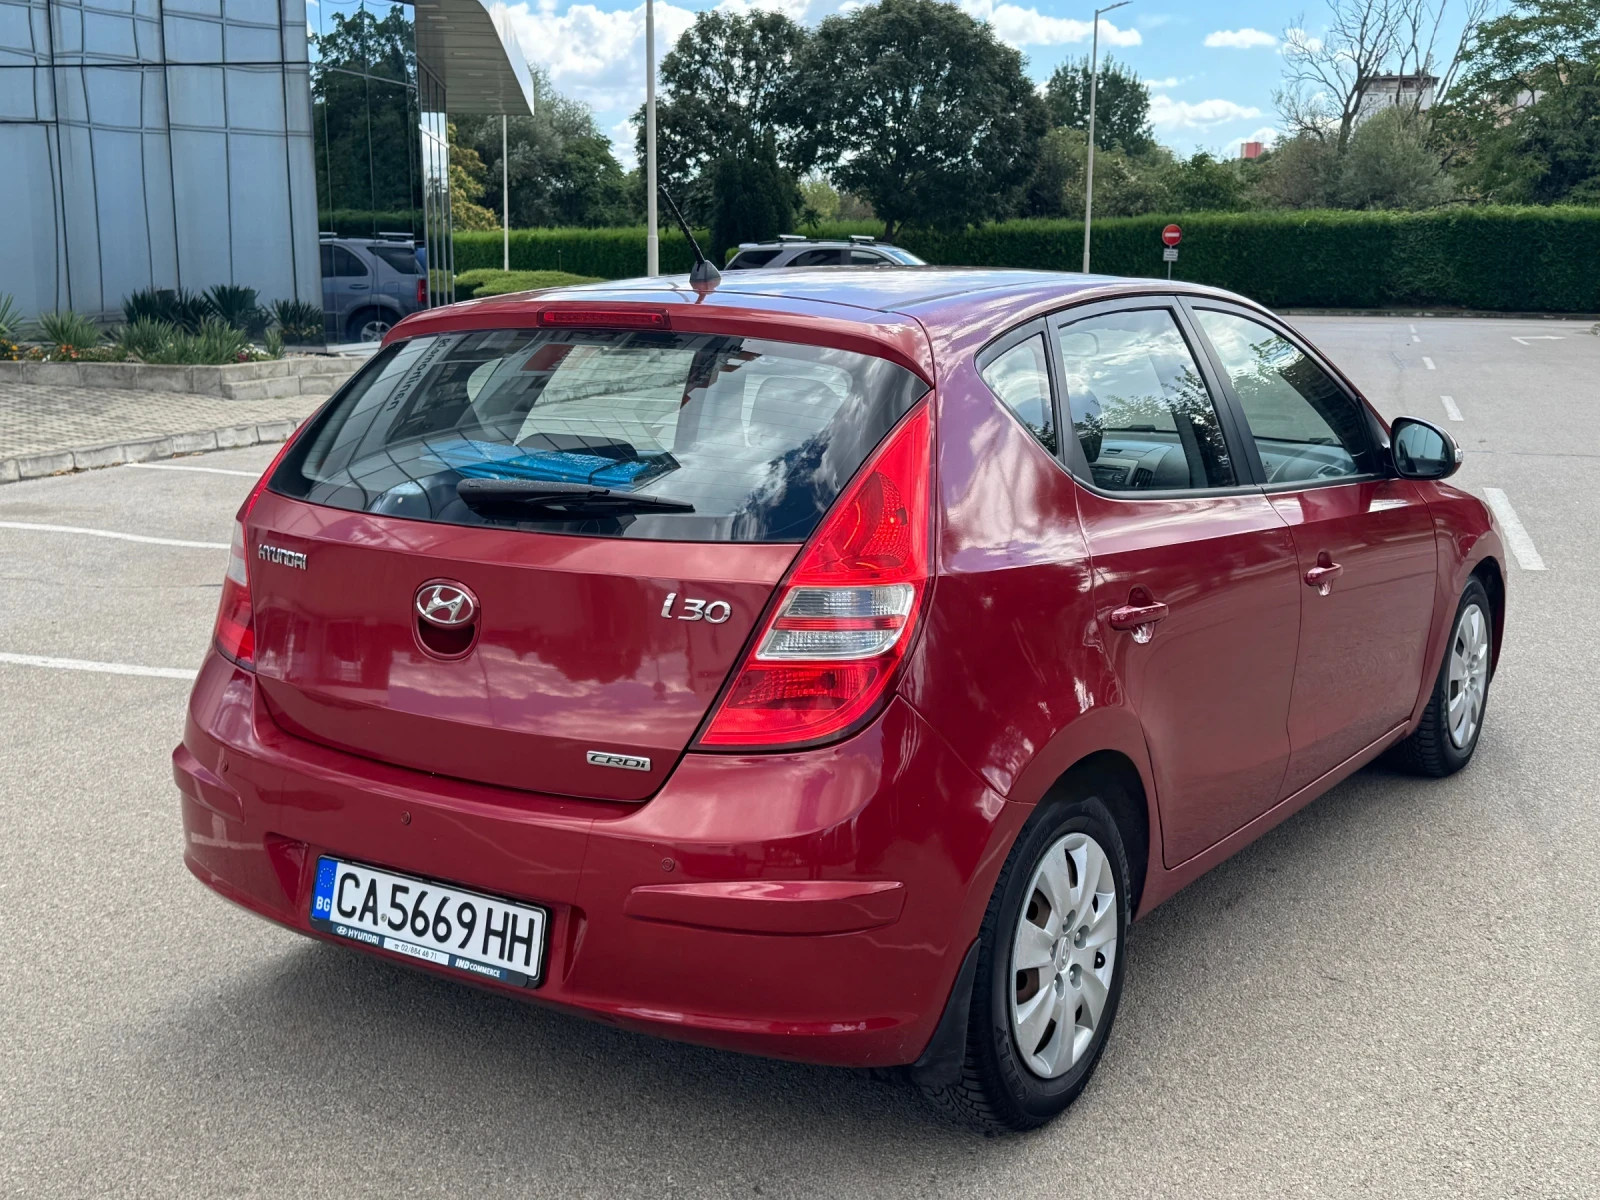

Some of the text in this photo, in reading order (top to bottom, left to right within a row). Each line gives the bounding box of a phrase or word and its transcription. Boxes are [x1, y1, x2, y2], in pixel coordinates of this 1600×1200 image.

[258, 543, 307, 571] HYUNDAI
[590, 754, 647, 768] CRDi
[315, 896, 331, 912] BG
[347, 928, 380, 945] HYUNDAI
